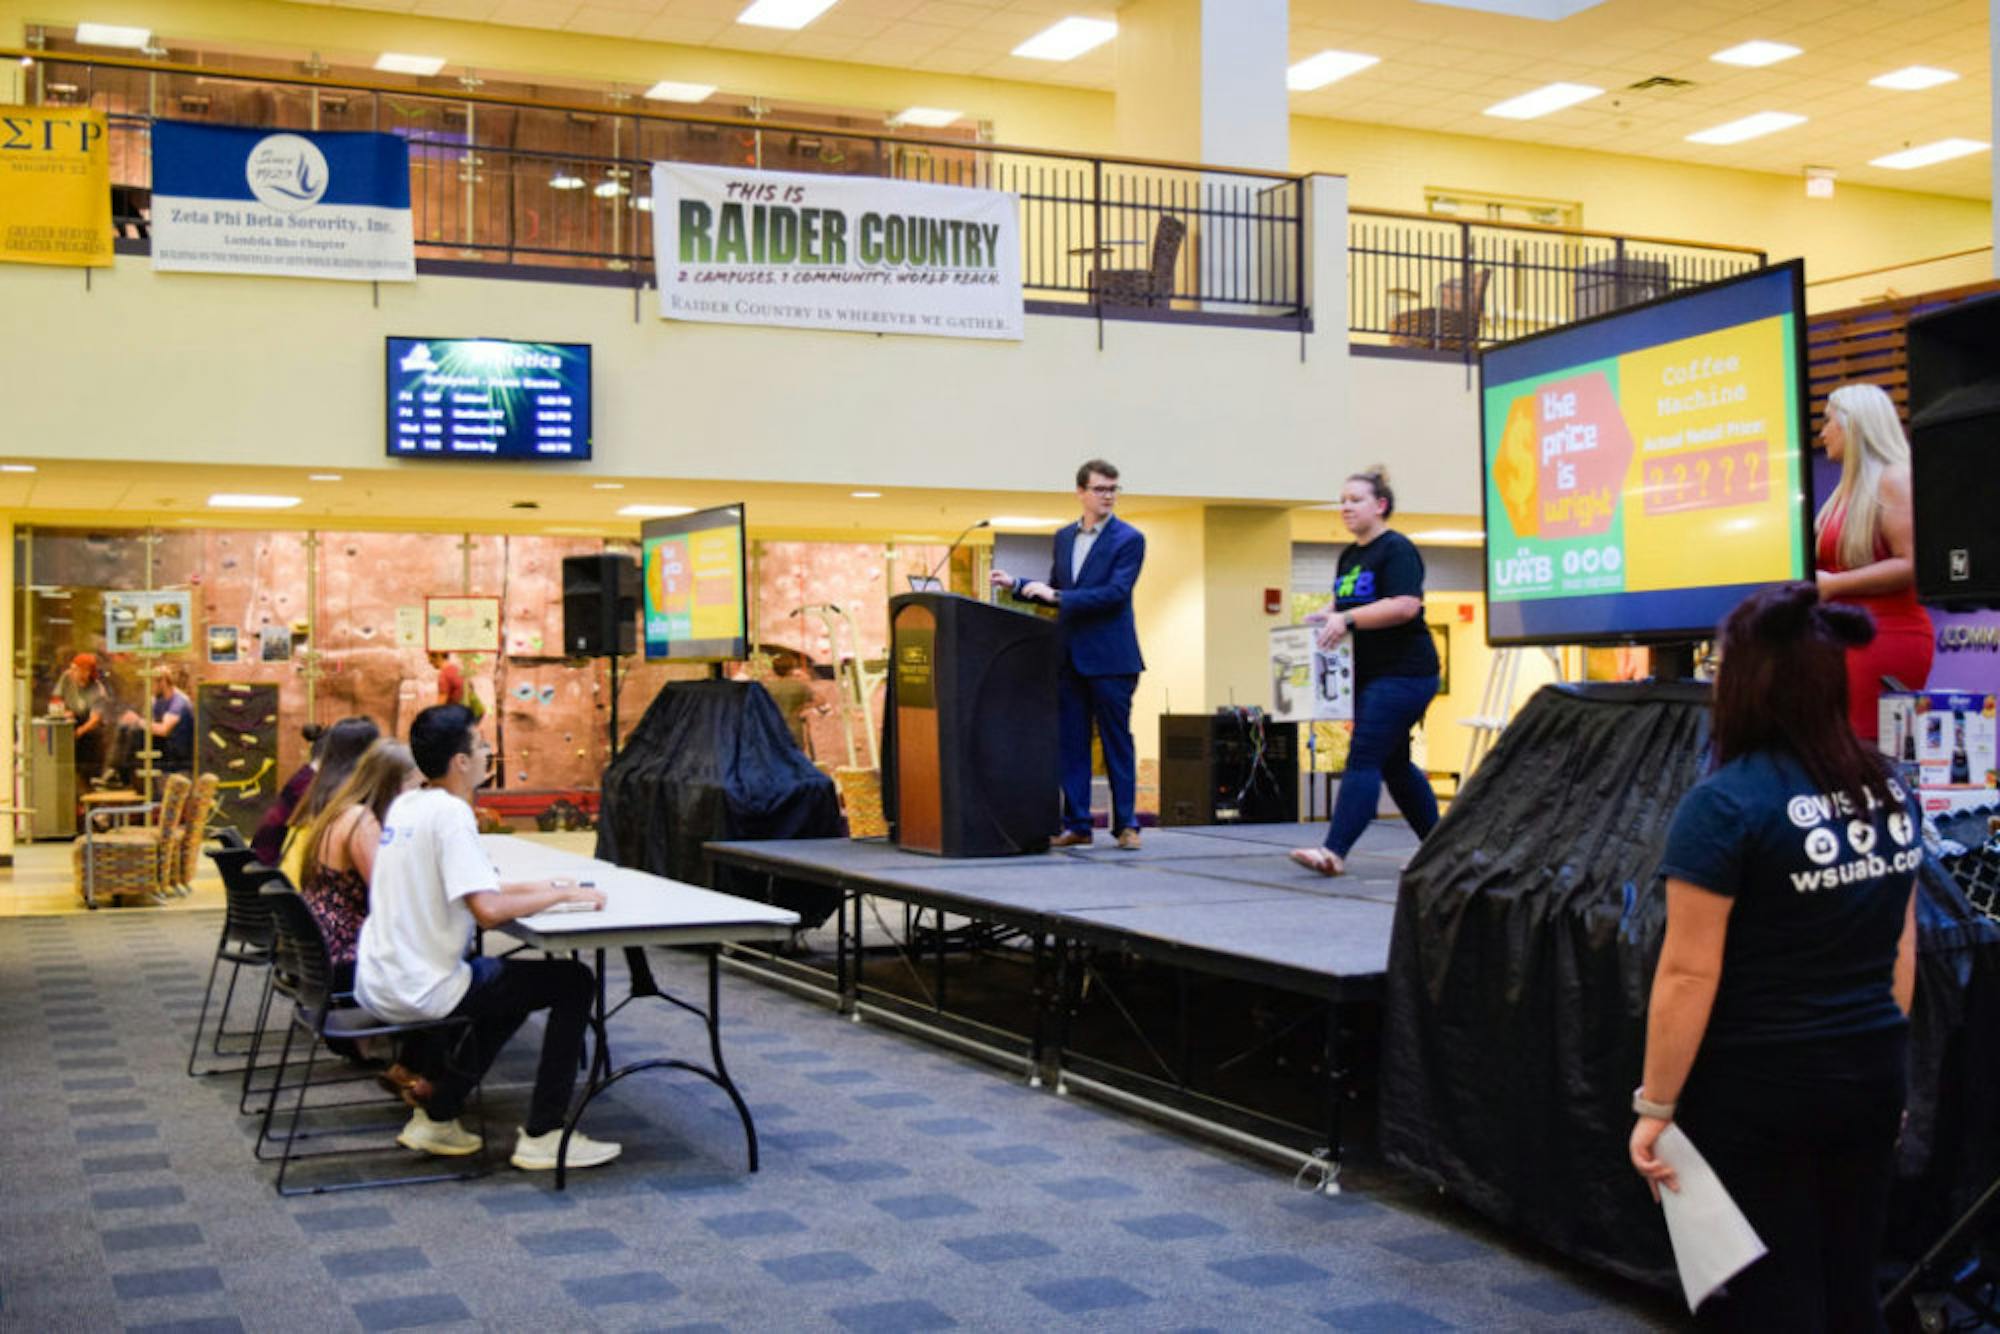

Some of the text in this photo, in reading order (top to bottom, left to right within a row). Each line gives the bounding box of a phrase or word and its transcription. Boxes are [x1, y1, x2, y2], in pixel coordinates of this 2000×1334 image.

[726, 182, 805, 203] THIS IS
[171, 209, 396, 234] Zeta Phi Beta Sorority, Inc.
[678, 199, 1000, 269] RAIDER COUNTRY
[224, 235, 272, 247] Lambda
[677, 270, 689, 282] 2
[897, 271, 945, 285] WORLD
[1661, 355, 1741, 387] Coffee
[1542, 391, 1577, 423] the
[1656, 384, 1748, 417] Machine
[1542, 422, 1598, 467] price
[1557, 460, 1576, 490] is
[1543, 487, 1614, 528] wright
